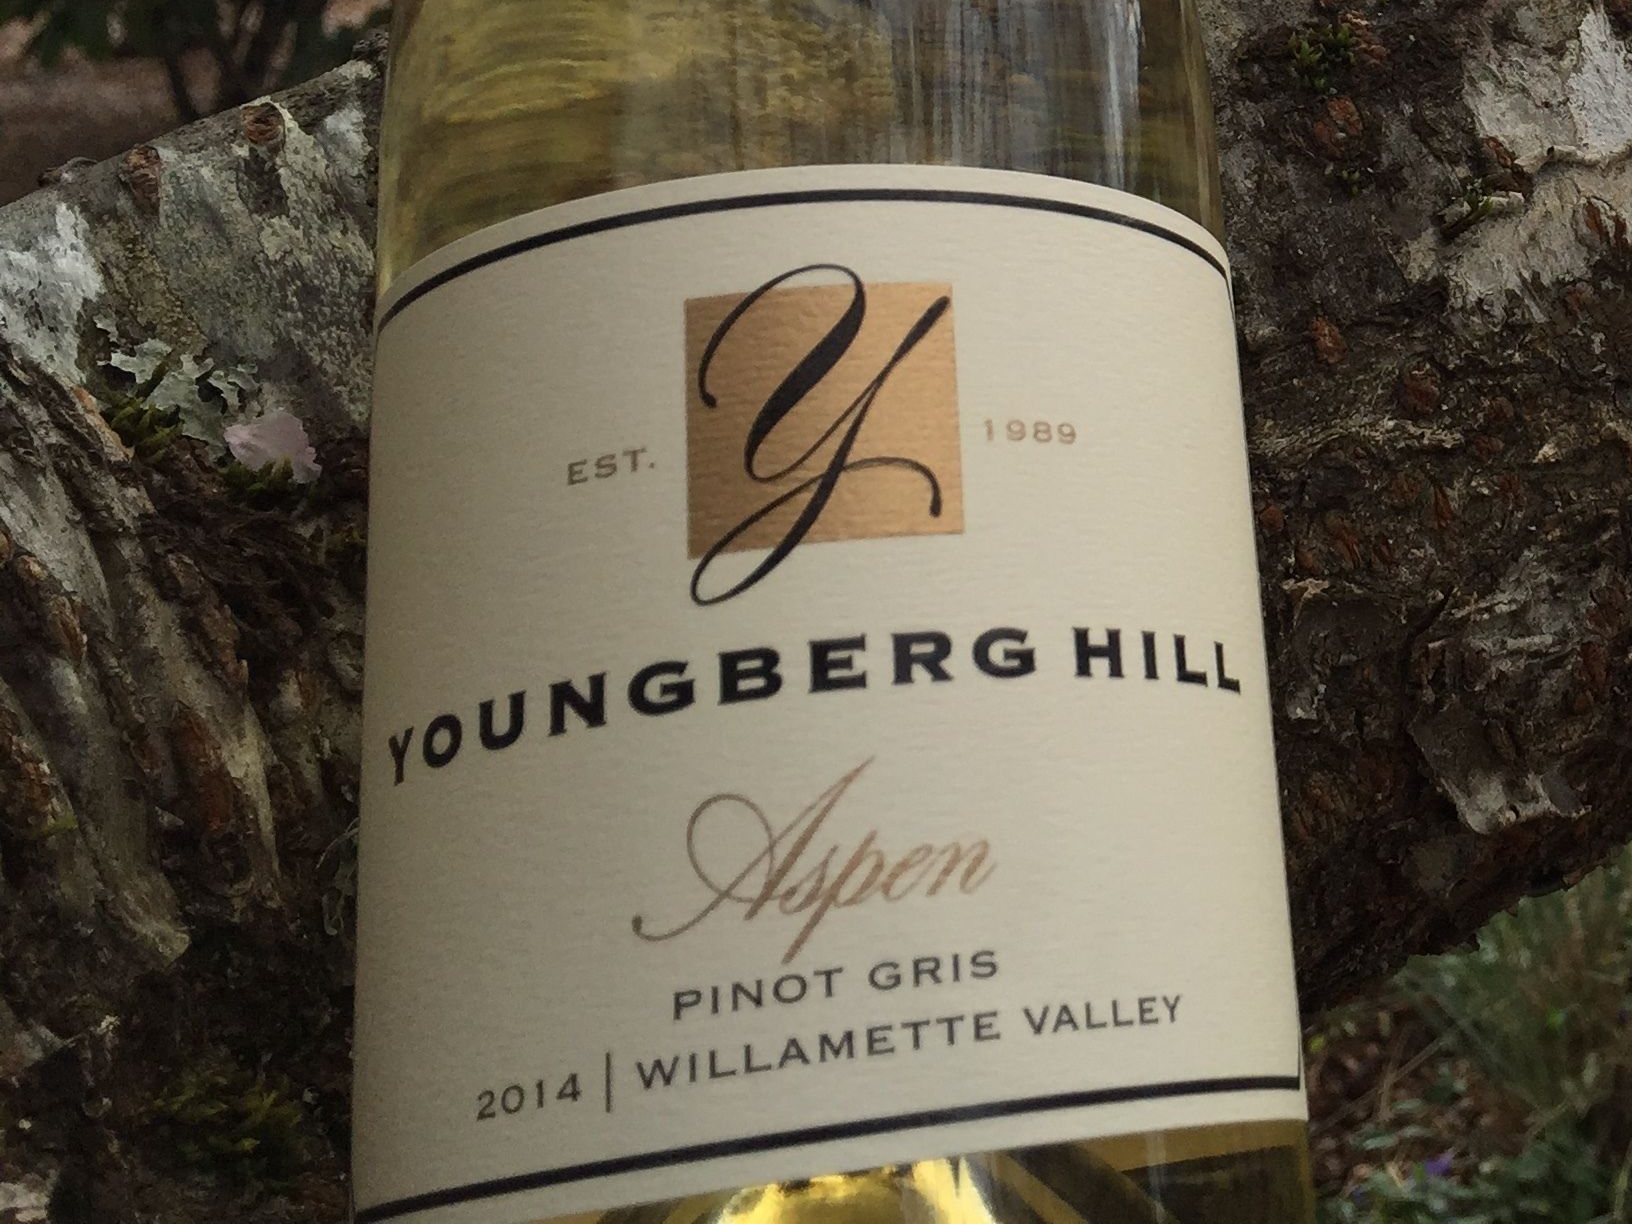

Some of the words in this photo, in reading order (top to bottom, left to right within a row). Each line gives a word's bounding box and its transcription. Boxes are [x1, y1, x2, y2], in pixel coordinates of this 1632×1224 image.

[566, 446, 657, 486] EST.
[981, 417, 1078, 447] 1989
[387, 627, 1037, 787] YOUNGBERG
[1072, 626, 1242, 694] HILL
[631, 755, 995, 965] Aspen
[672, 967, 844, 1021] PINOT
[868, 949, 1000, 990] GRIS
[475, 1073, 584, 1121] 2014
[636, 1011, 1002, 1091] WILLAMETTE
[1023, 994, 1184, 1037] VALLEY
